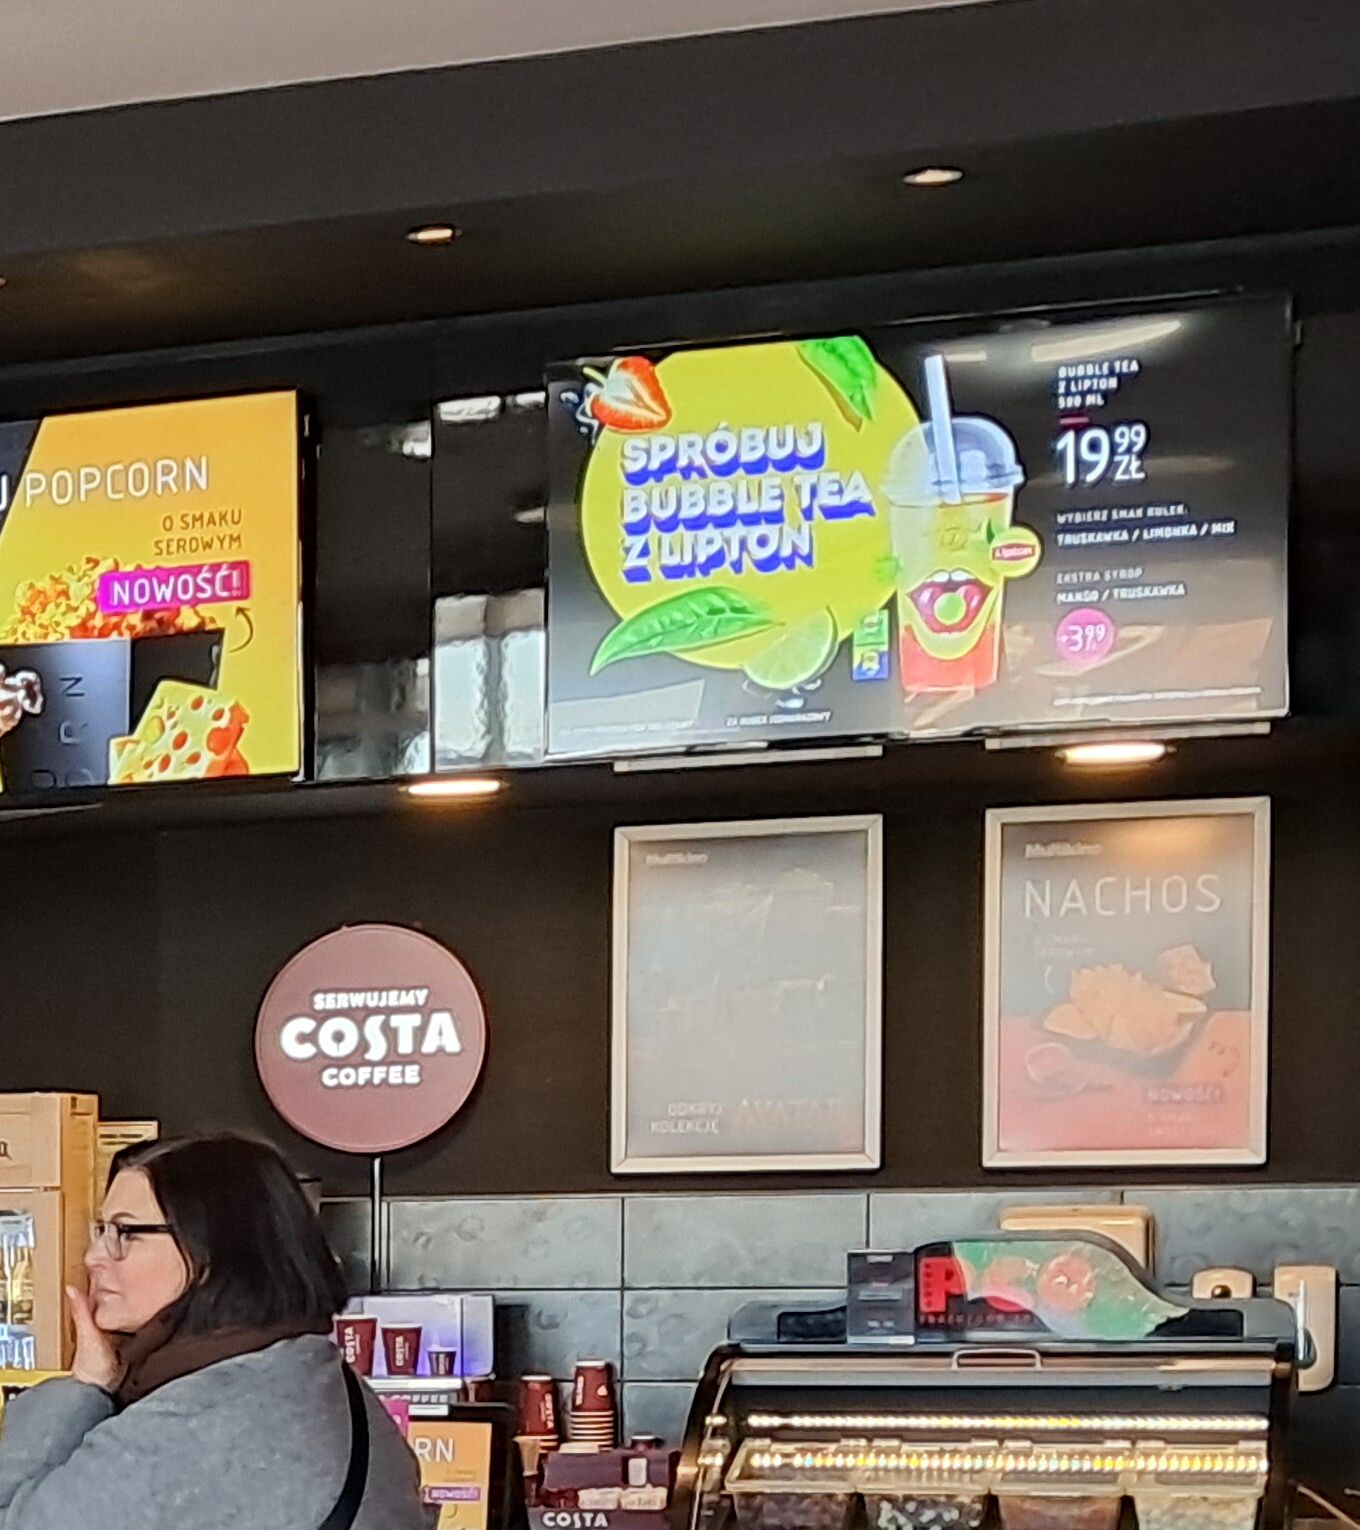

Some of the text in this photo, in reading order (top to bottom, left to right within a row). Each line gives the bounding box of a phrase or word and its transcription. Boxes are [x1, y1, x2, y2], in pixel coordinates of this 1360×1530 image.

[1057, 359, 1140, 379] BUBBLE TEA
[1070, 377, 1118, 393] LIPTON
[621, 421, 826, 480] SPRÓBUJ
[24, 456, 209, 508] POPCORN
[622, 471, 877, 531] BUBBLE TEA
[162, 508, 243, 532] O SMAKU
[1056, 509, 1109, 525] WYBIERZ
[153, 533, 243, 557] SEROWYM
[622, 524, 814, 577] Z LIPTON
[111, 568, 242, 607] NOWOŚĆ!
[1024, 873, 1223, 919] NACHOS
[312, 987, 430, 1010] SERWUJEMY
[280, 1011, 462, 1062] COSTA
[321, 1064, 422, 1088] COFFEE
[542, 1511, 609, 1529] COSTA
